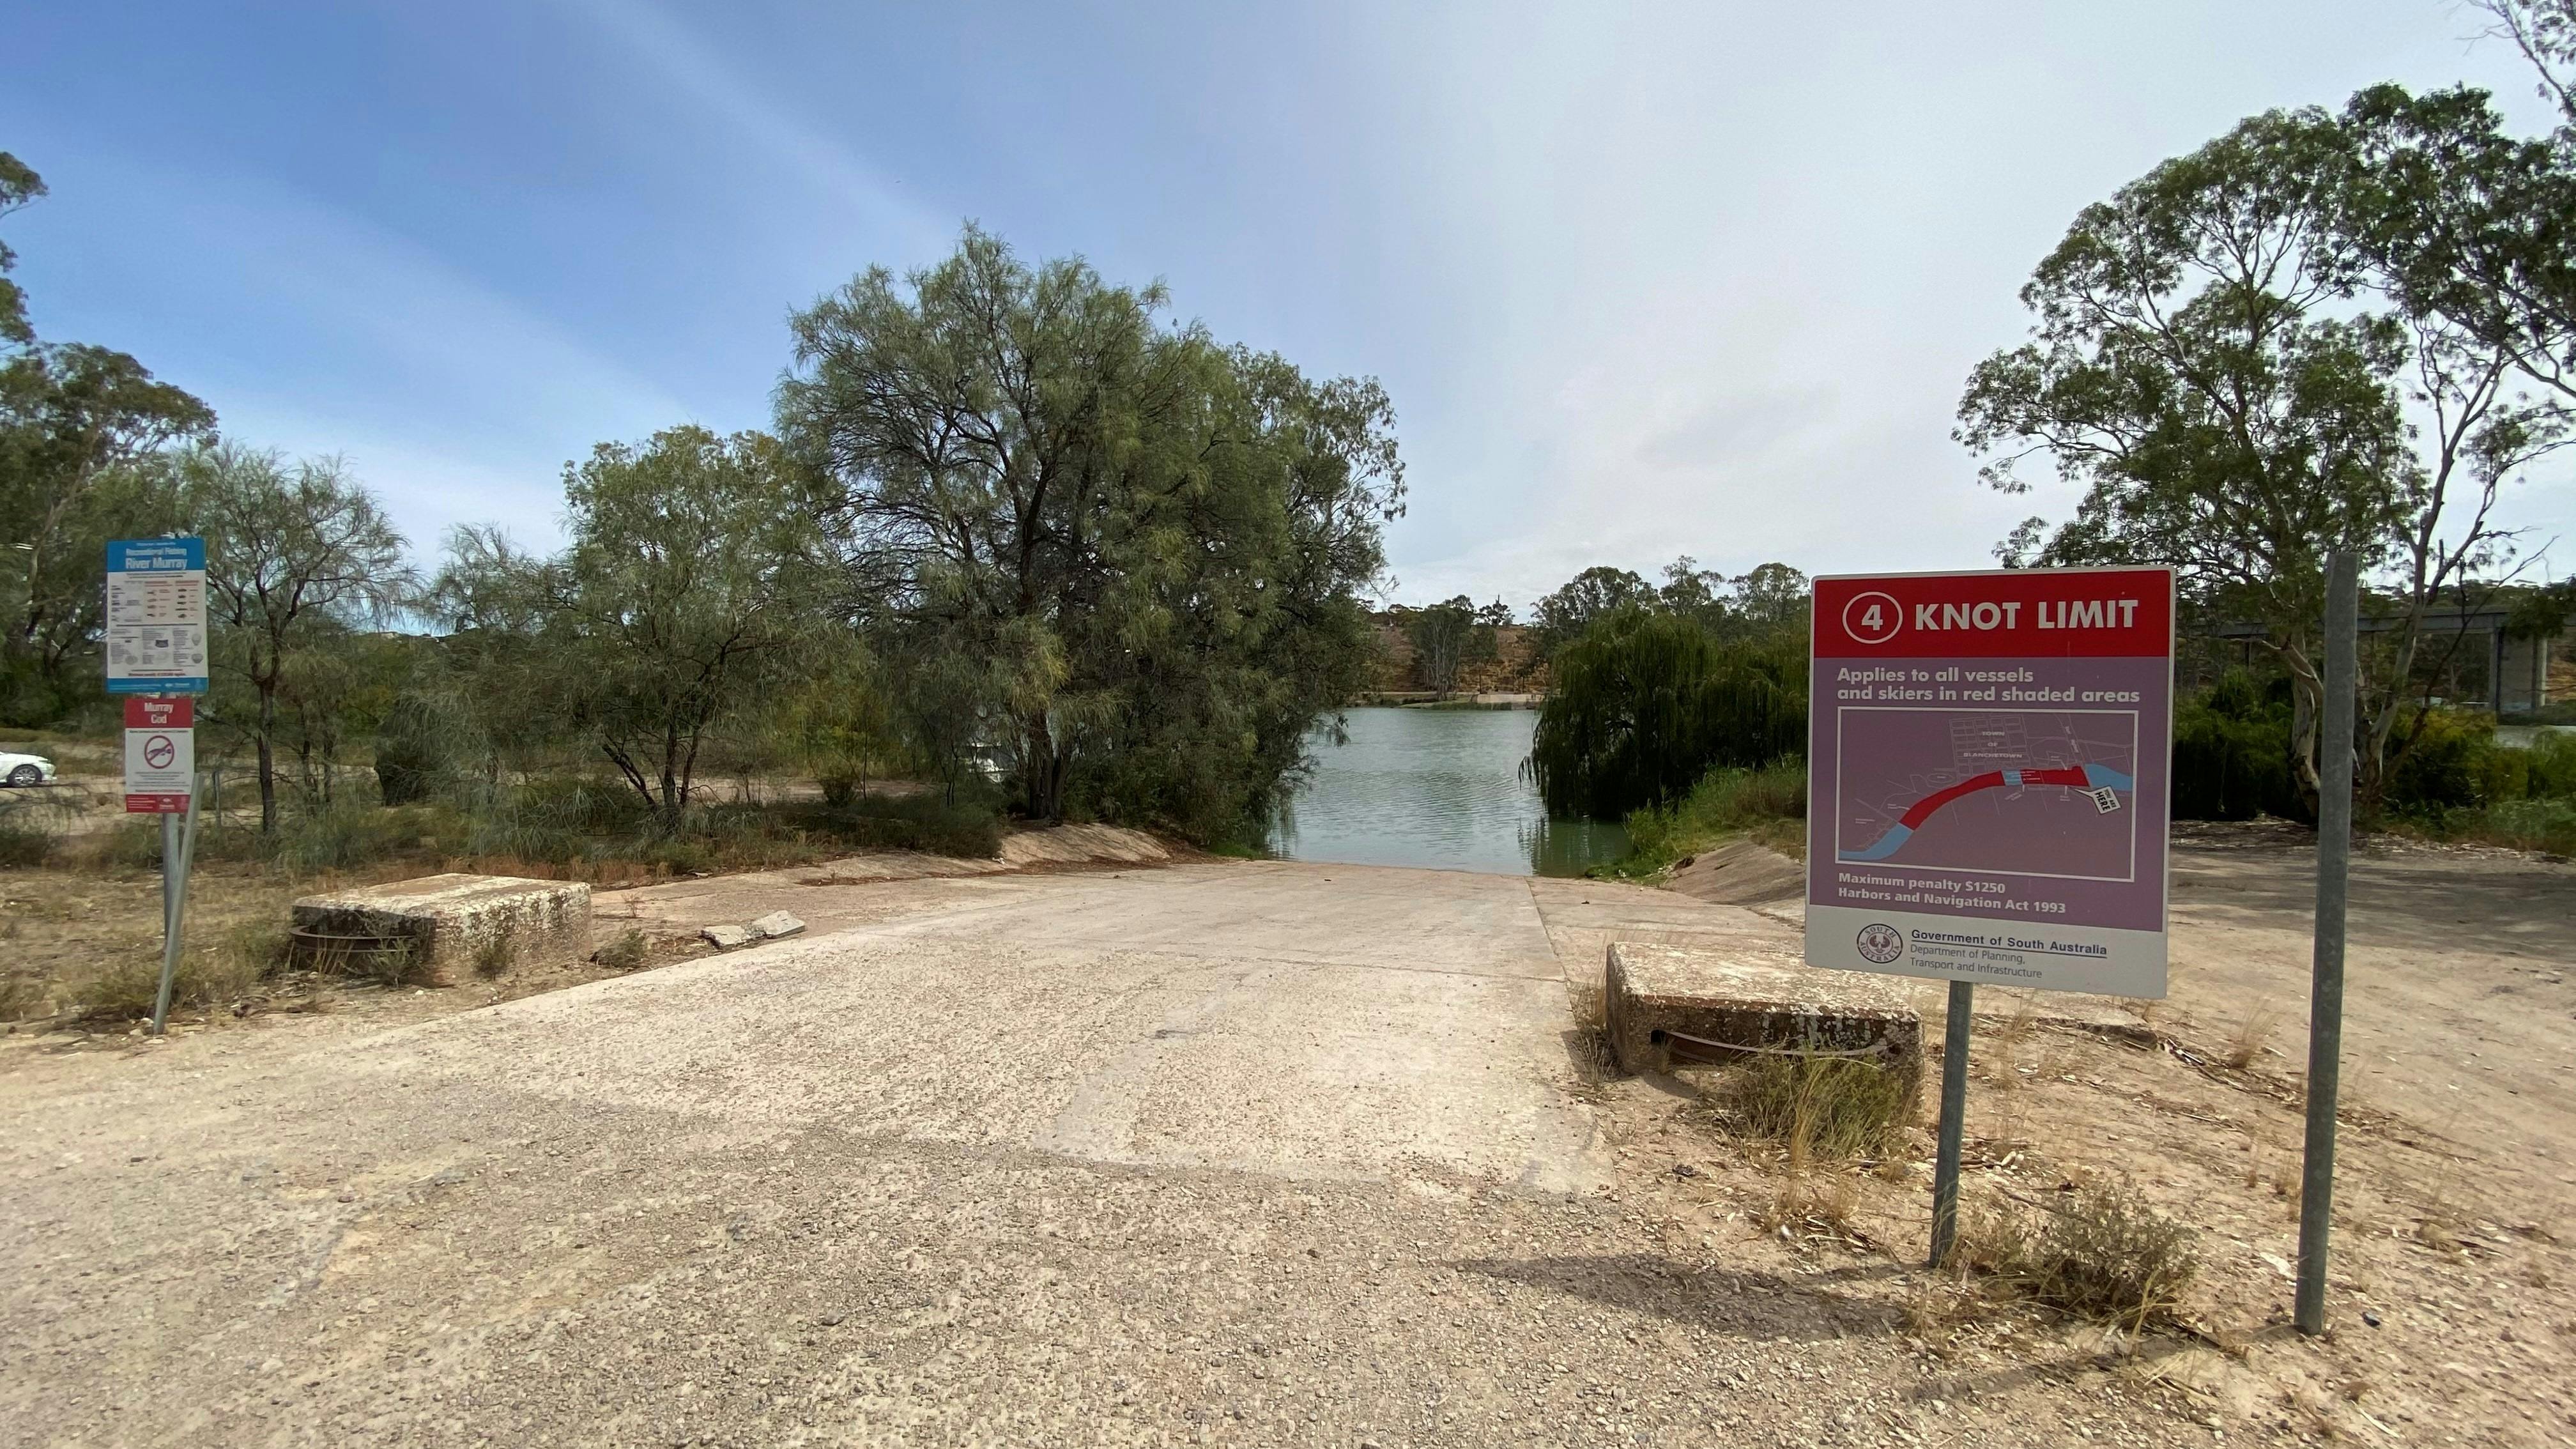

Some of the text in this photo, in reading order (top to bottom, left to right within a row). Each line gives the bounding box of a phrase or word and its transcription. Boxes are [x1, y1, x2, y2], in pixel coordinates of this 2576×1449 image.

[125, 556, 188, 570] River Murray
[1861, 599, 2138, 631] 4 KNOT LIMIT
[1837, 667, 2034, 684] Applies to all vessels
[1837, 686, 2140, 702] and skiers in red shaded areas
[144, 702, 174, 713] Murray
[151, 714, 167, 724] Cod
[2094, 791, 2111, 811] HERE
[1839, 873, 2005, 893] Maximum penalty $1250
[1838, 887, 2066, 913] Harbors and Navigation Act 1993
[1865, 926, 1897, 939] SOUTH
[1910, 944, 1966, 958] Department
[1968, 949, 1979, 958] of
[1912, 930, 2107, 954] Government of South Australia
[1860, 941, 1900, 962] AUSTRALIA
[1910, 957, 2043, 978] Transport and Infrastructure
